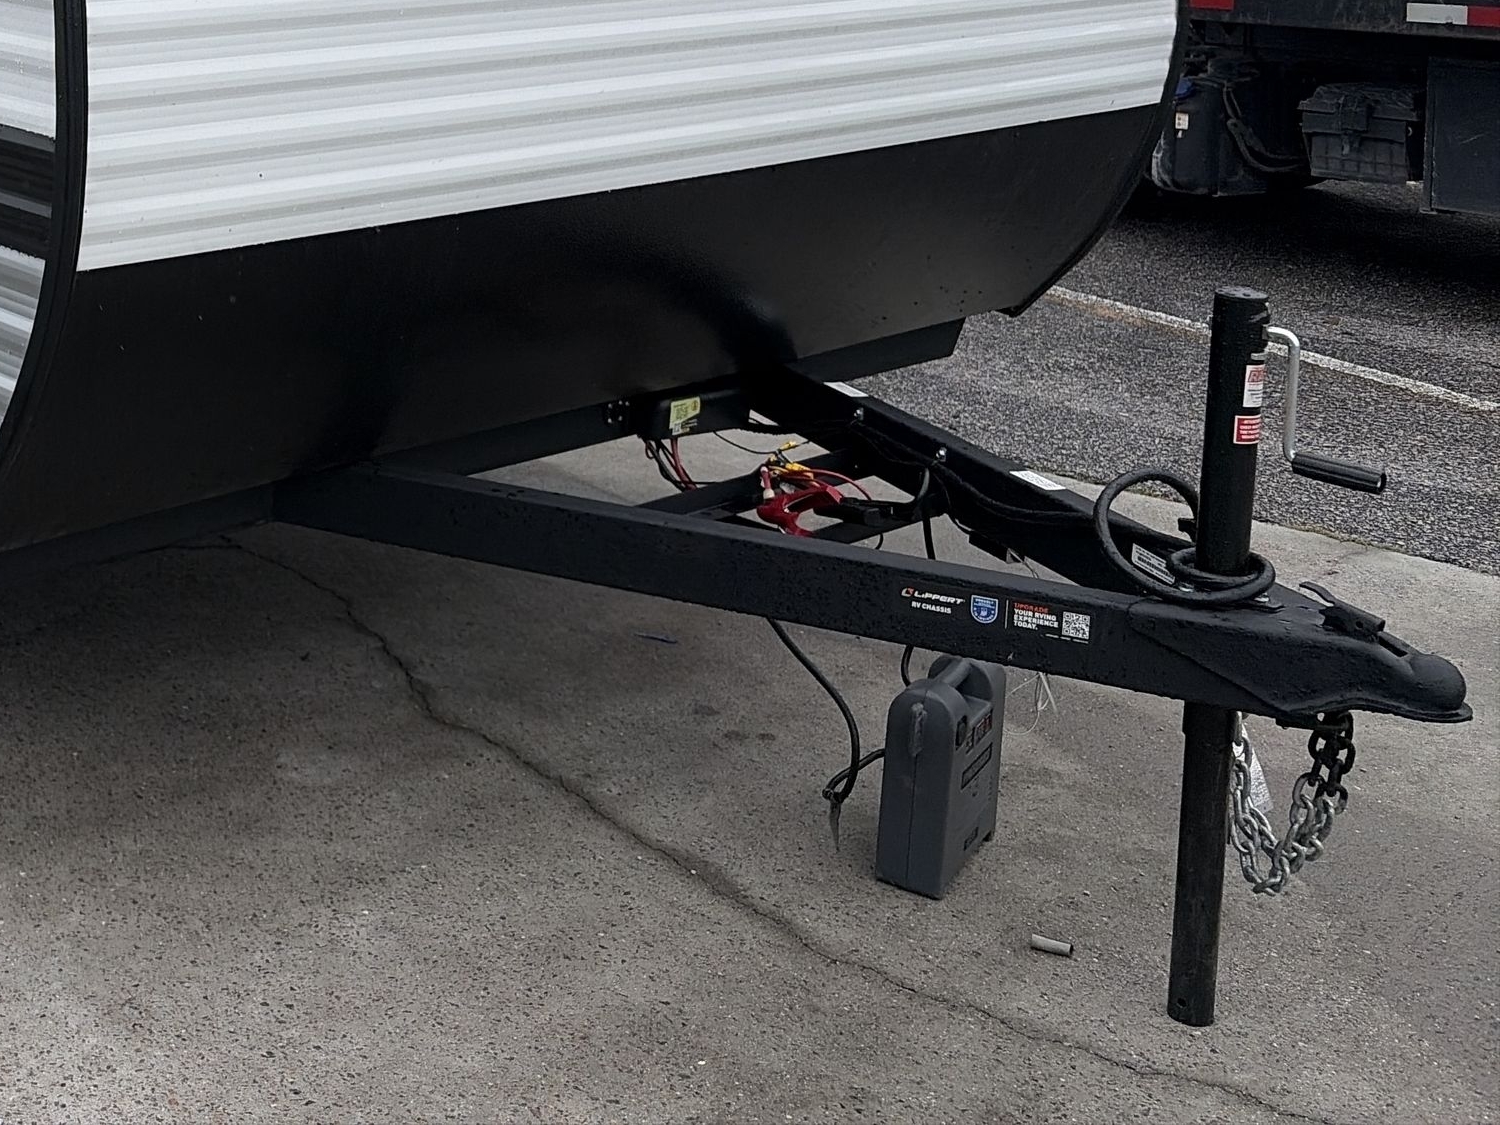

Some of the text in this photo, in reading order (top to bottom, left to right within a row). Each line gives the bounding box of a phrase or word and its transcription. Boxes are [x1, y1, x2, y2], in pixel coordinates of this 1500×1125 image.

[911, 600, 952, 615] RV CHASSIS
[1014, 602, 1049, 614] UPGRADE
[1013, 614, 1059, 629] EXPERIENCE
[1014, 608, 1057, 622] YOUR RVING
[1014, 620, 1039, 631] TODAY.
